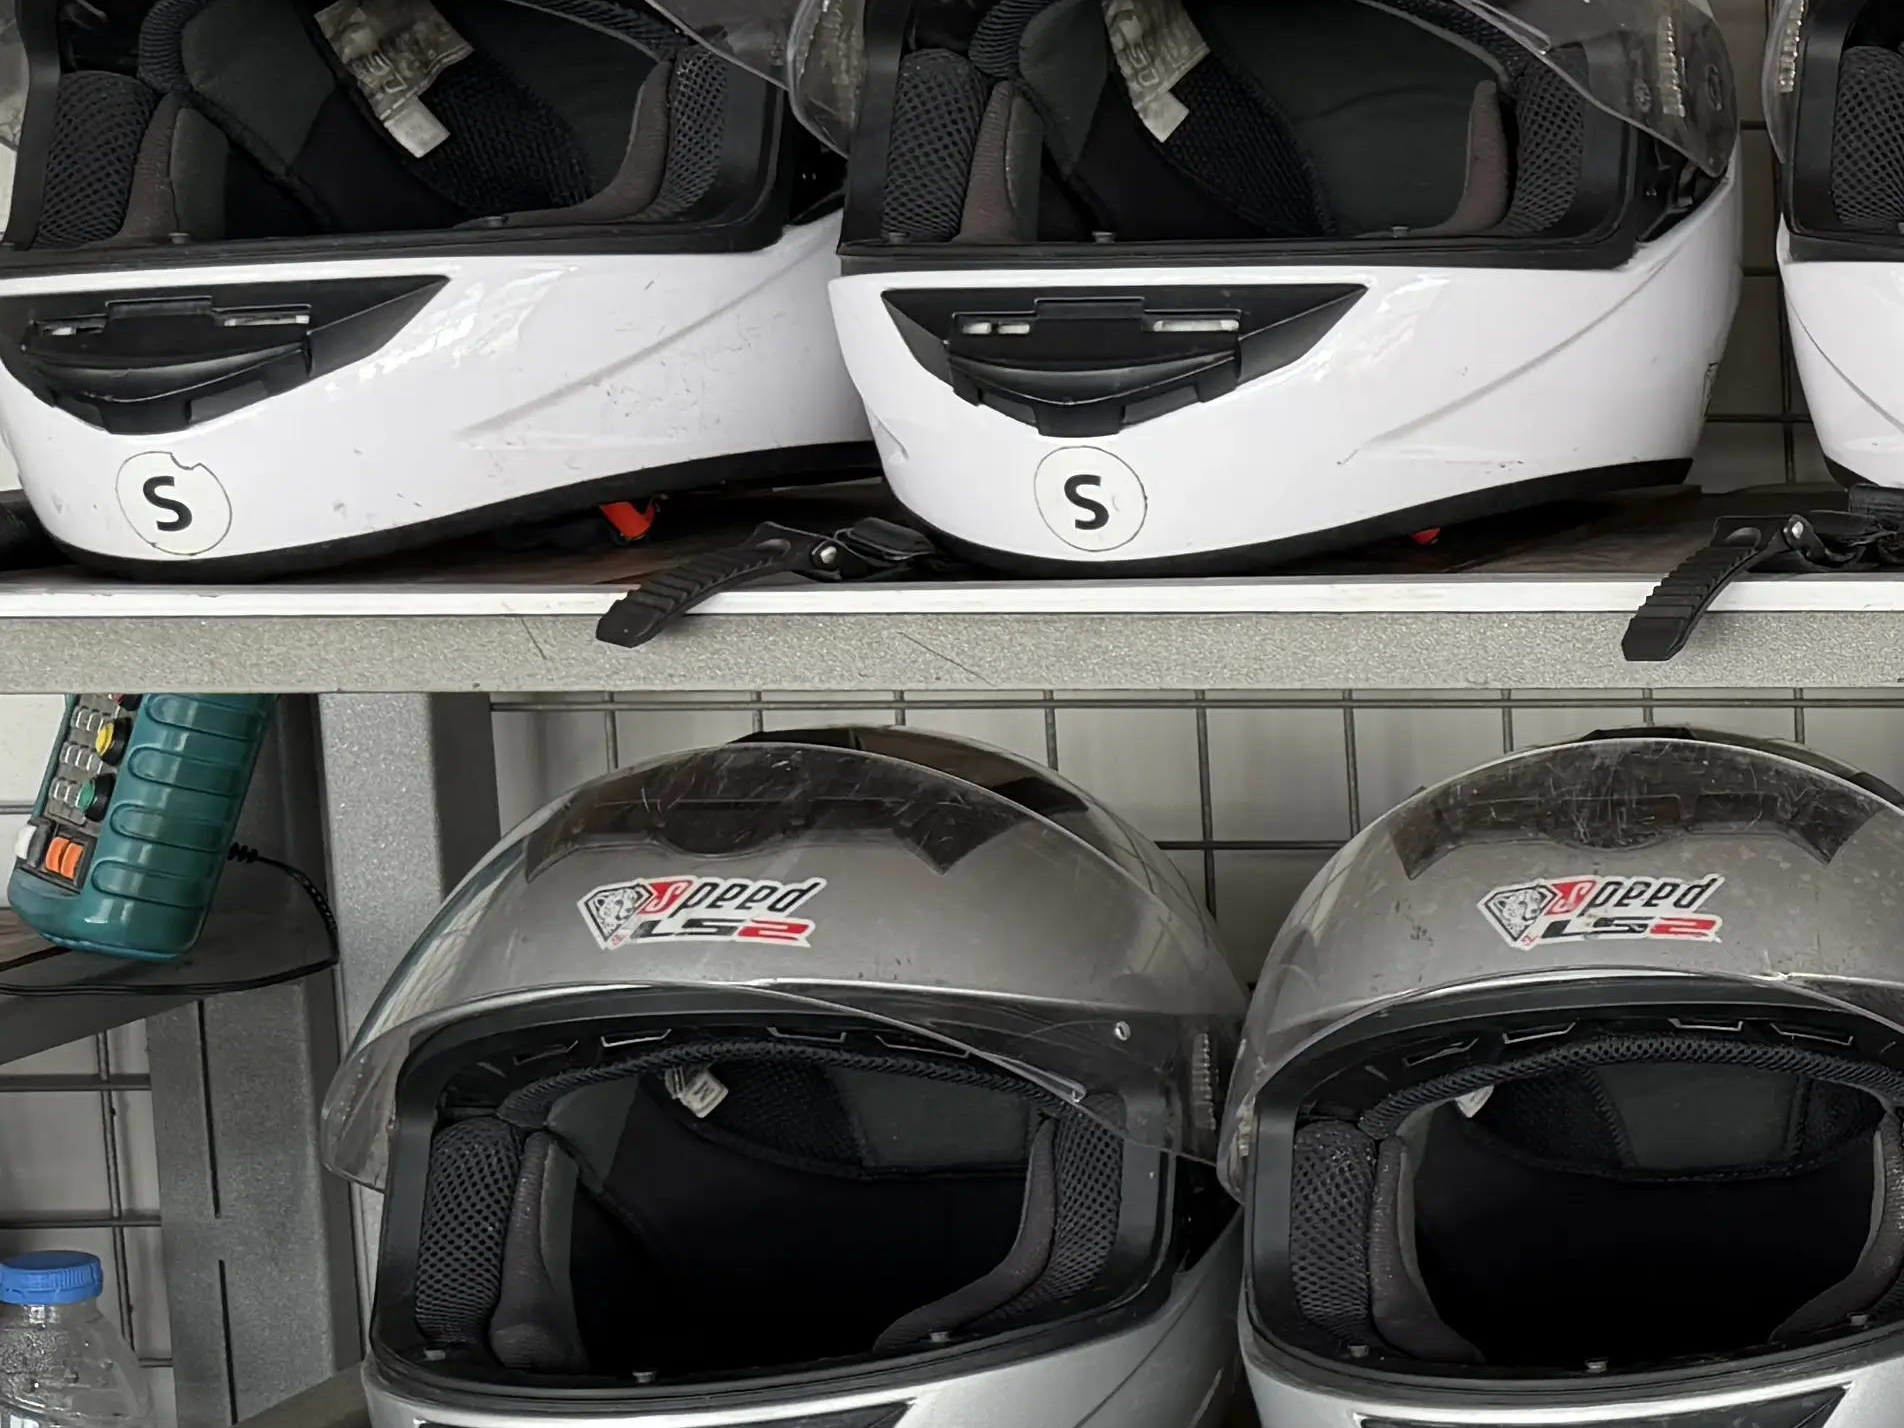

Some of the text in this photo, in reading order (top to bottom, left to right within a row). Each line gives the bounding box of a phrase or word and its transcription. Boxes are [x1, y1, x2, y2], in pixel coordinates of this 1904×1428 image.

[143, 476, 191, 531] S
[1065, 475, 1109, 529] S
[640, 880, 822, 918] Speed
[1545, 877, 1719, 918] Speed
[630, 918, 811, 940] LS2
[1540, 917, 1717, 938] LS2
